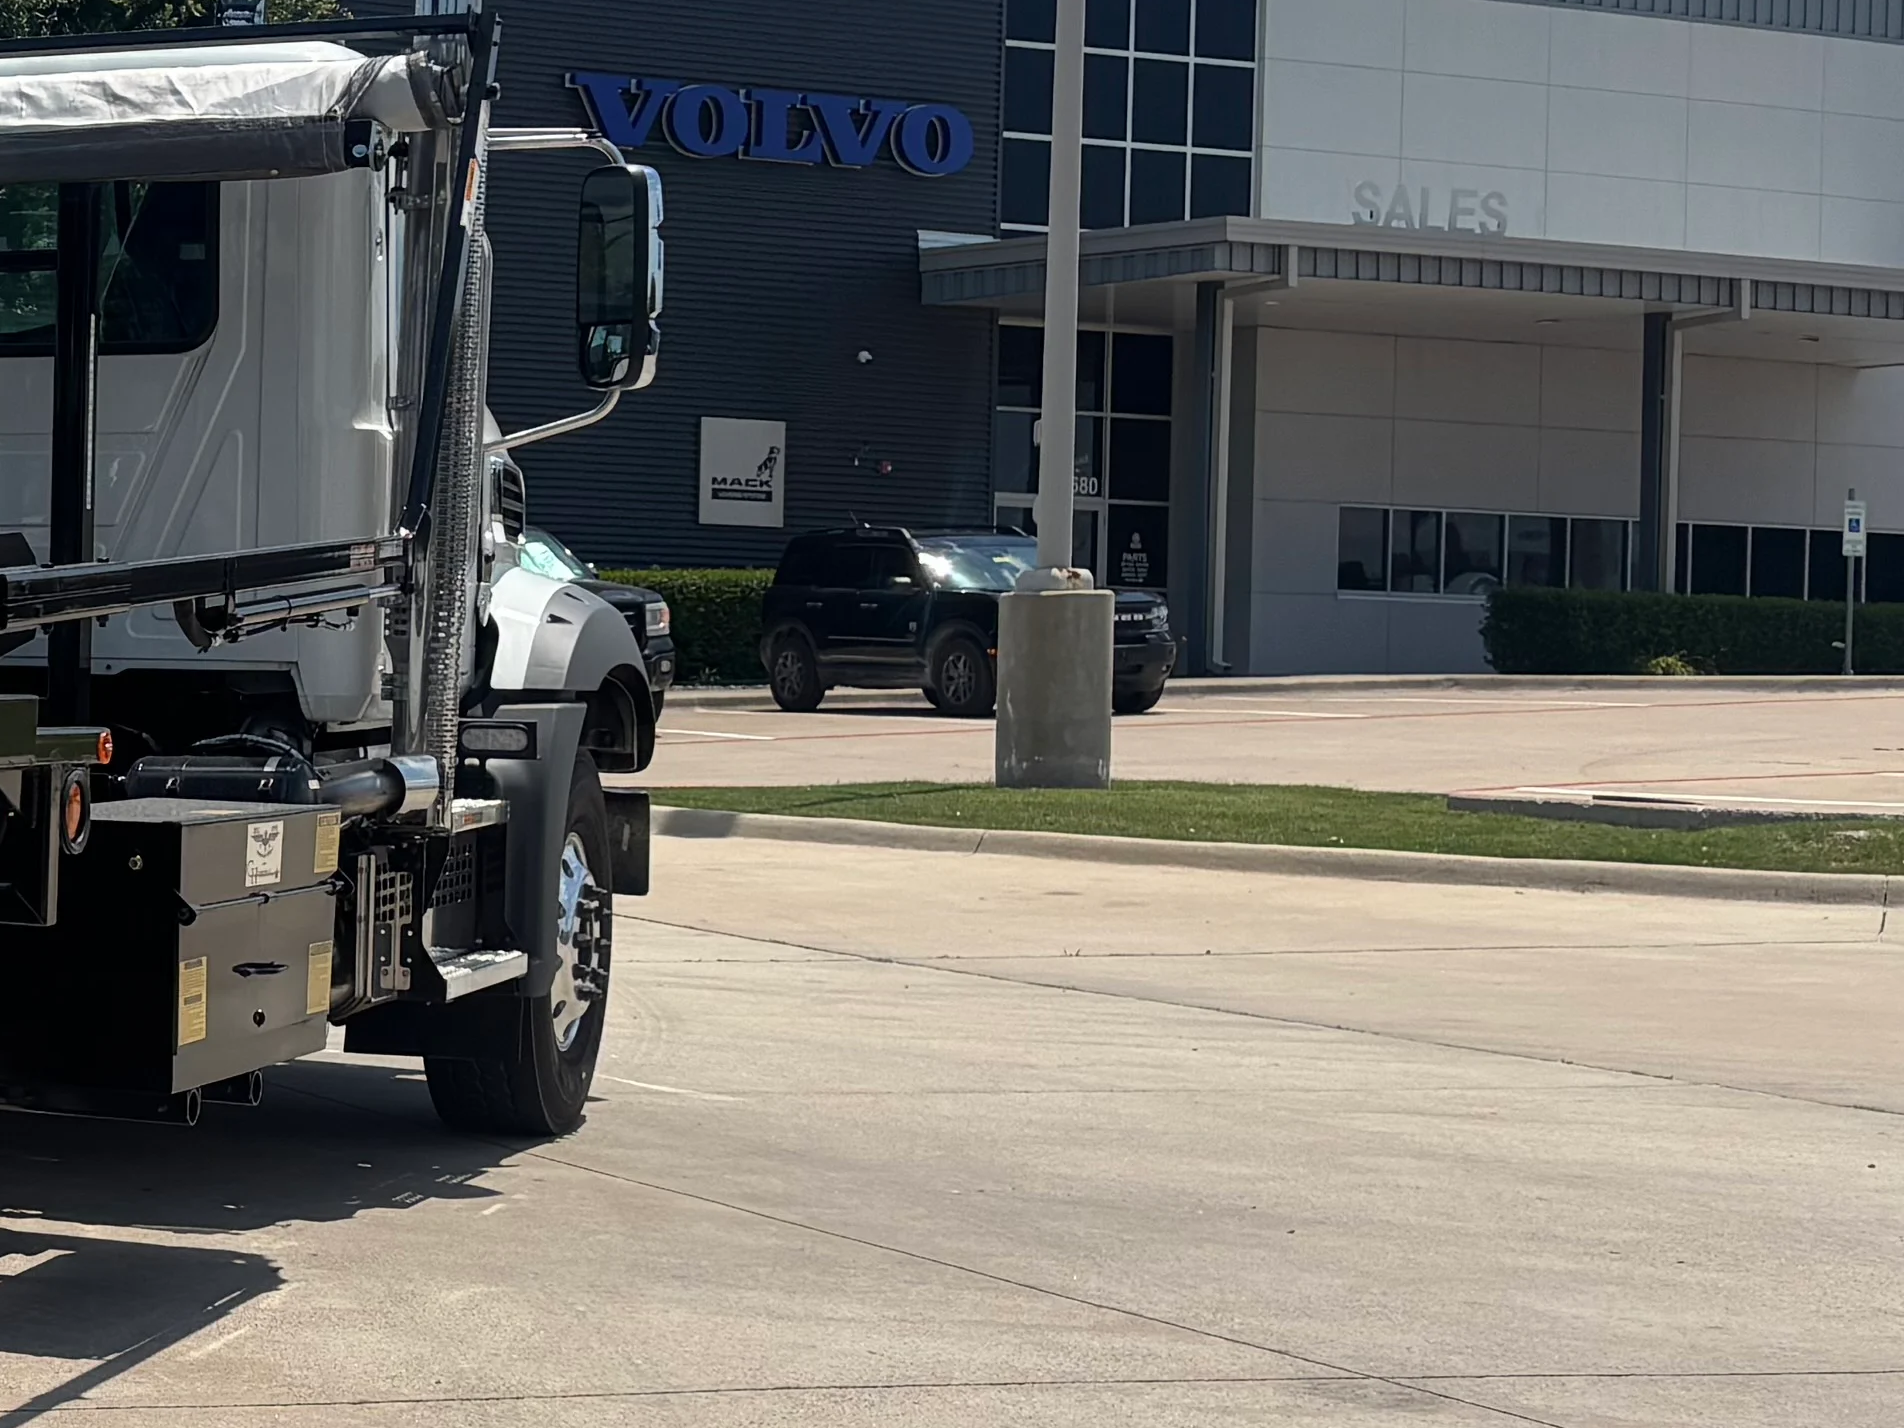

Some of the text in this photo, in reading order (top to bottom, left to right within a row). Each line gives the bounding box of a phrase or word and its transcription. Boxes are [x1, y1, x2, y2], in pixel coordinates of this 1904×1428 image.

[565, 72, 975, 177] VOLVO
[1352, 180, 1508, 240] SALES
[712, 477, 773, 489] MACK
